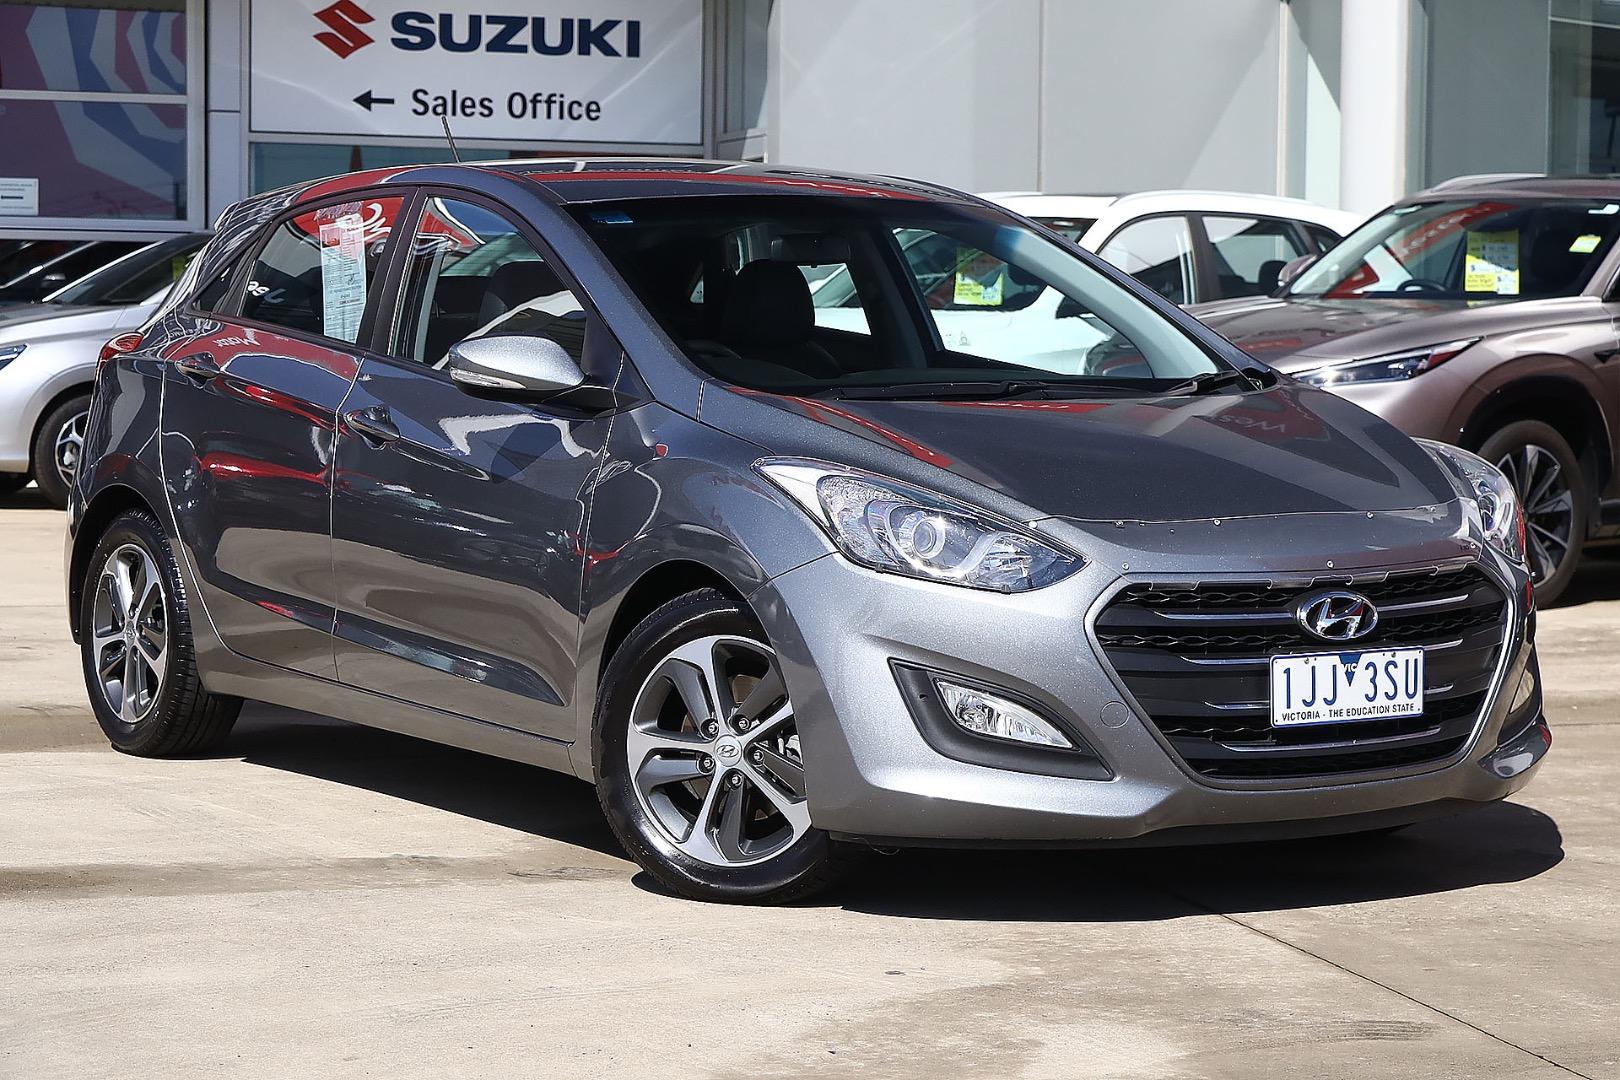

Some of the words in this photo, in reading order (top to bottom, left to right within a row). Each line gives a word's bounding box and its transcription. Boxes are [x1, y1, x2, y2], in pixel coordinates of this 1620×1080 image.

[391, 11, 640, 58] SUZUKI
[412, 88, 493, 118] Sales
[508, 92, 601, 121] Office
[1283, 664, 1338, 709] 1JJ
[1364, 658, 1418, 702] 3SU
[1343, 663, 1357, 673] VIC
[1282, 711, 1320, 721] VICTORIA
[1329, 708, 1344, 718] THE
[1346, 706, 1390, 716] EDUCATION
[1392, 703, 1414, 713] STATE
